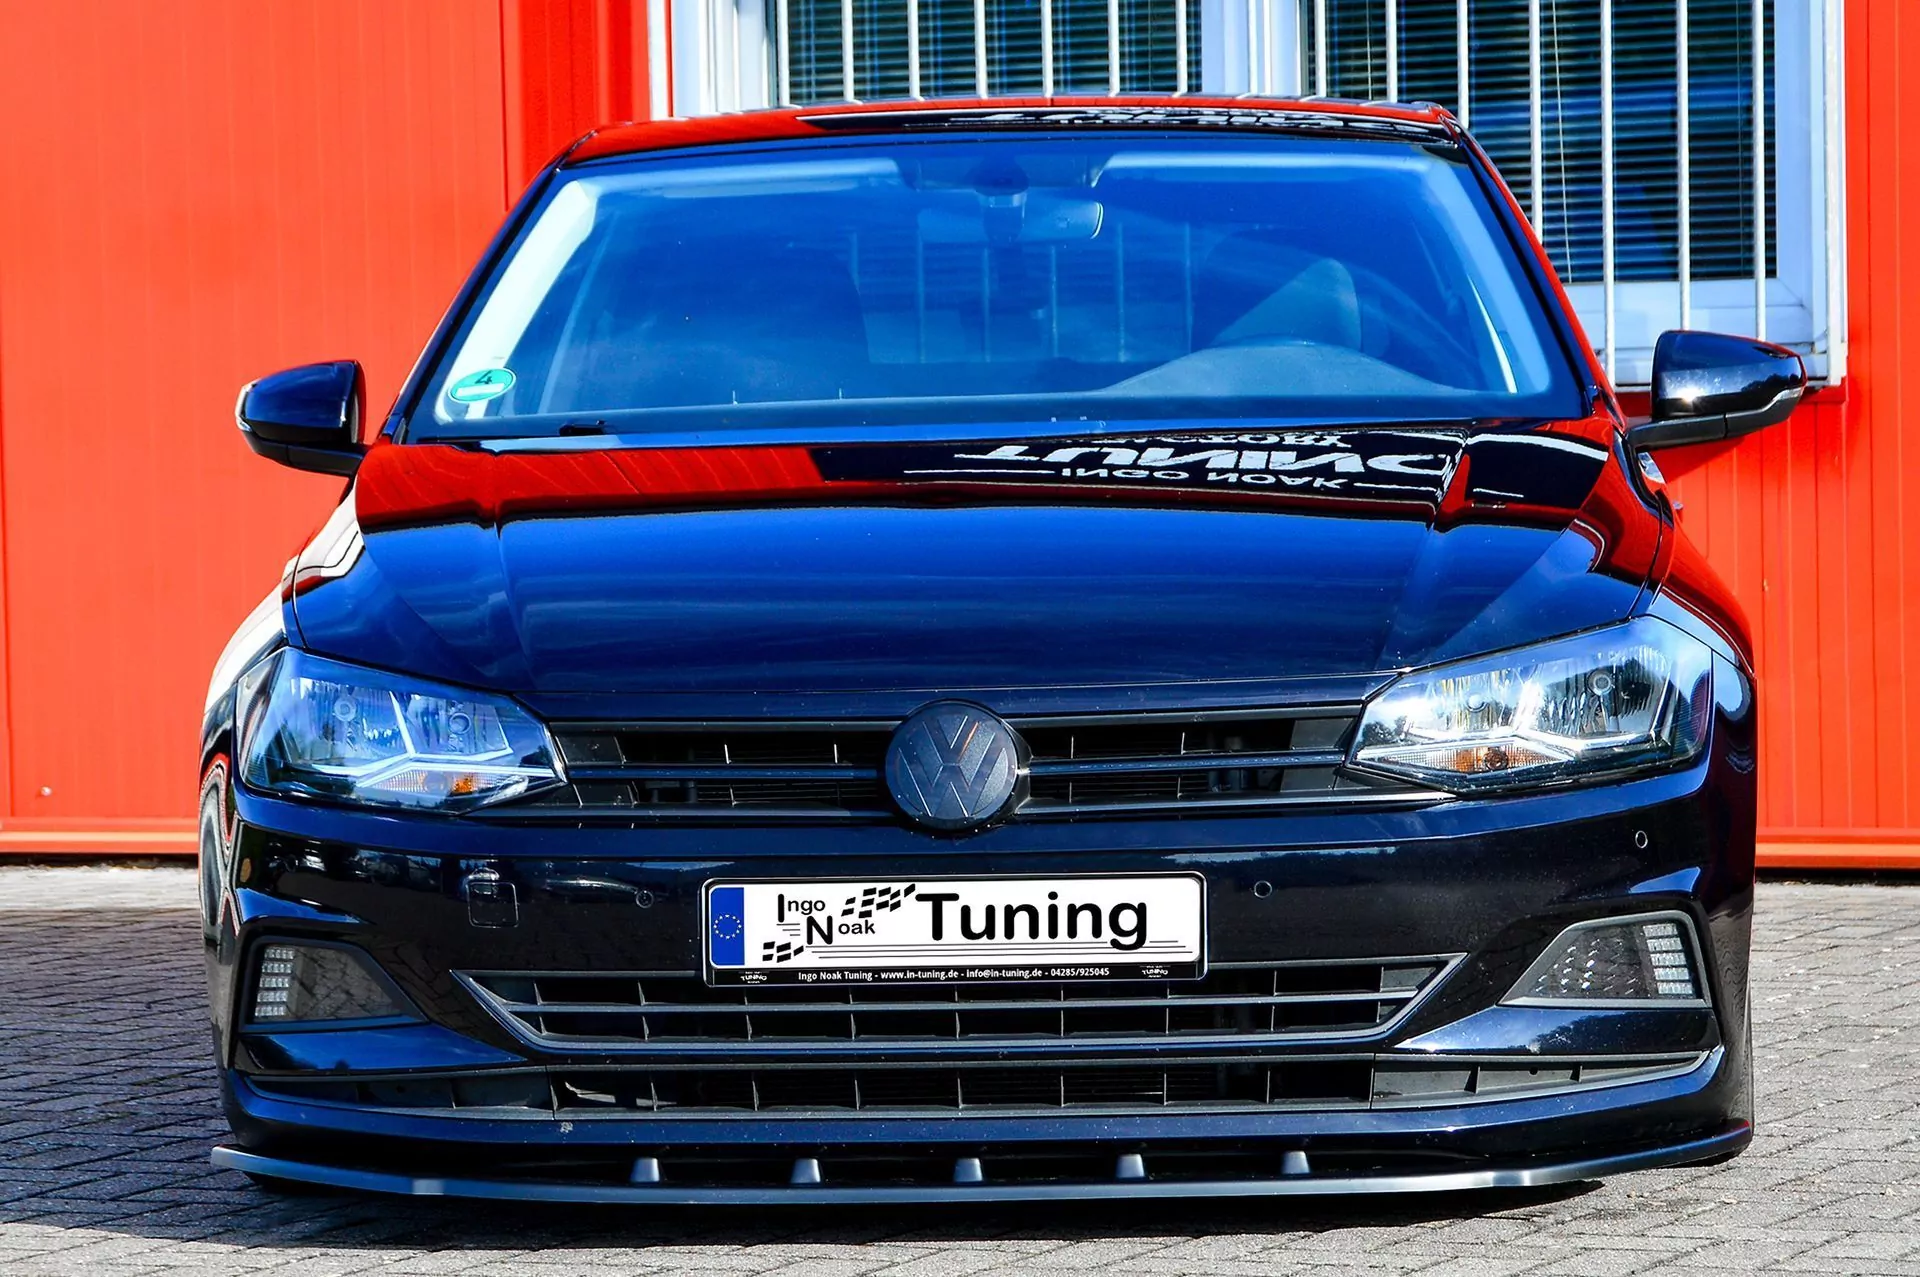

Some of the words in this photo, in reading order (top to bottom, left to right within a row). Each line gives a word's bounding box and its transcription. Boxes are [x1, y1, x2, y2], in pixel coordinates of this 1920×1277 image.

[474, 369, 493, 385] 4
[777, 893, 826, 923] Ingo
[914, 890, 1148, 952] Tuning
[806, 915, 877, 946] Noak
[797, 971, 818, 982] Ingo
[819, 971, 842, 980] Noak
[843, 971, 873, 982] Tuning
[880, 969, 959, 980] www.in-tuning.de
[966, 968, 1043, 979] info@in-tuning.de
[1050, 967, 1110, 977] 04285/925045
